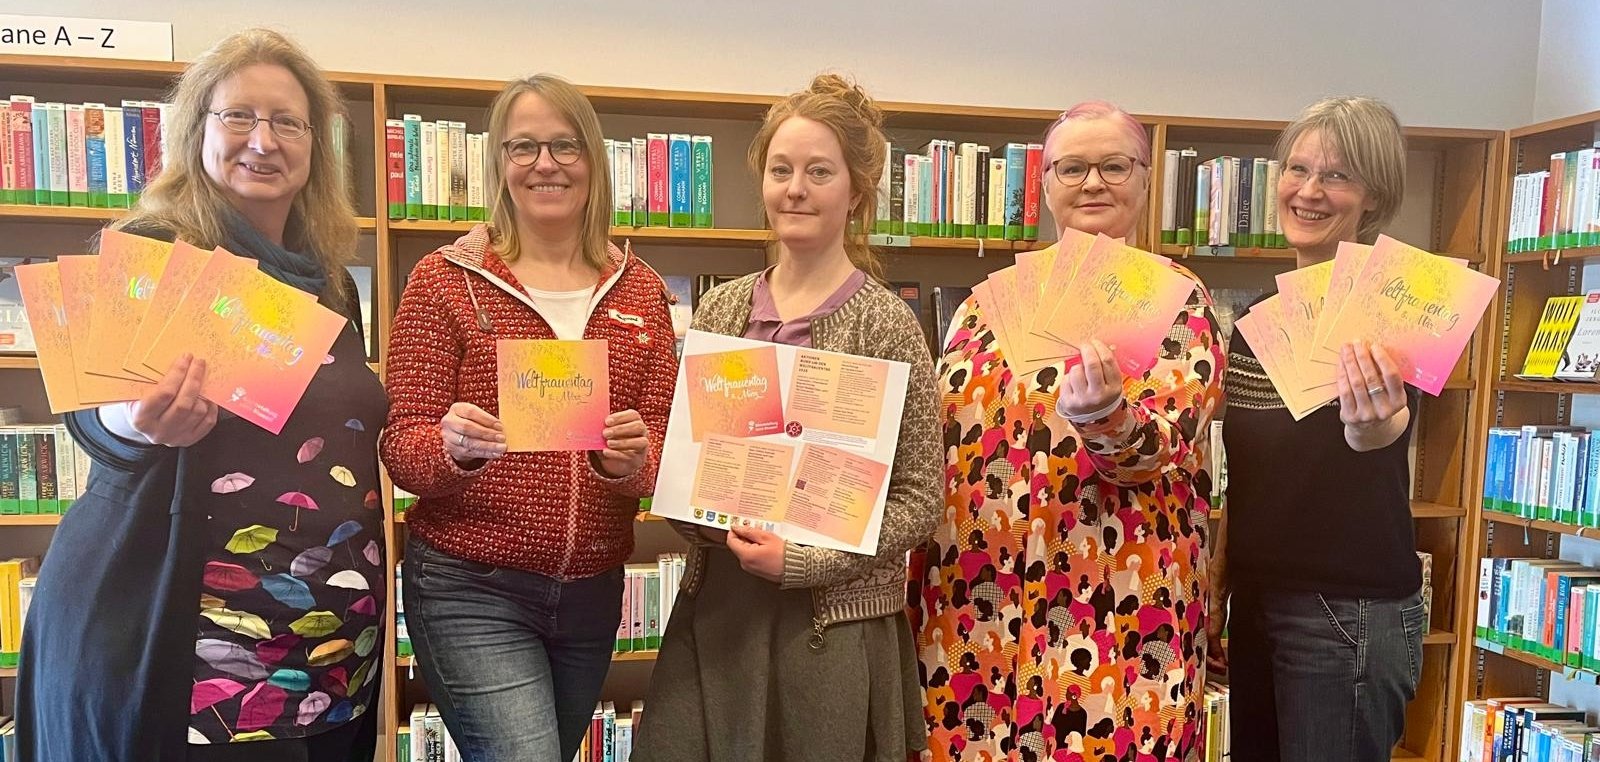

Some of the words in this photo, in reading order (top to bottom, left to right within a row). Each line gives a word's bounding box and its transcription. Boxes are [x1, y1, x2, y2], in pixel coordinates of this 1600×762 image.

[1, 28, 46, 44] ane
[54, 26, 72, 46] A
[100, 28, 116, 48] Z
[1370, 272, 1460, 332] Weltfrauentag
[1532, 328, 1569, 353] HAAS
[510, 368, 593, 398] Weltfrauentag
[701, 373, 768, 398] Weltfrauentag
[40, 443, 48, 480] WARWICK
